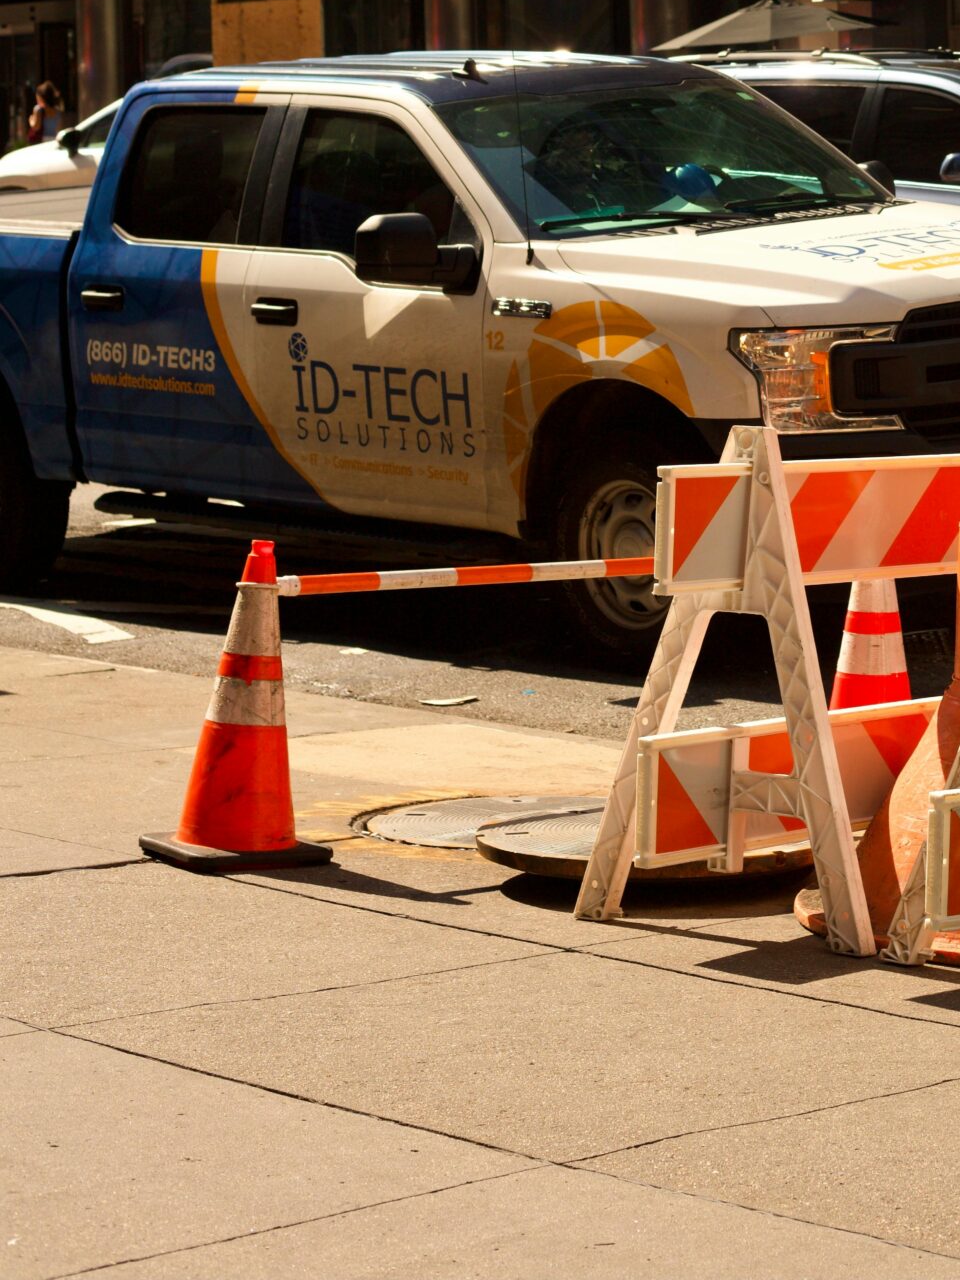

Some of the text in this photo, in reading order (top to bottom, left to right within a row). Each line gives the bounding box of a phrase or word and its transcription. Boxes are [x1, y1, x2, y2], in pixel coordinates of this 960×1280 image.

[86, 339, 216, 372] (866) ID-TECH3
[485, 330, 505, 351] 12
[90, 371, 216, 397] www.idtechsolutions.com
[297, 416, 476, 458] SOLUTIONS
[333, 455, 414, 477] Communications
[427, 465, 469, 485] Security
